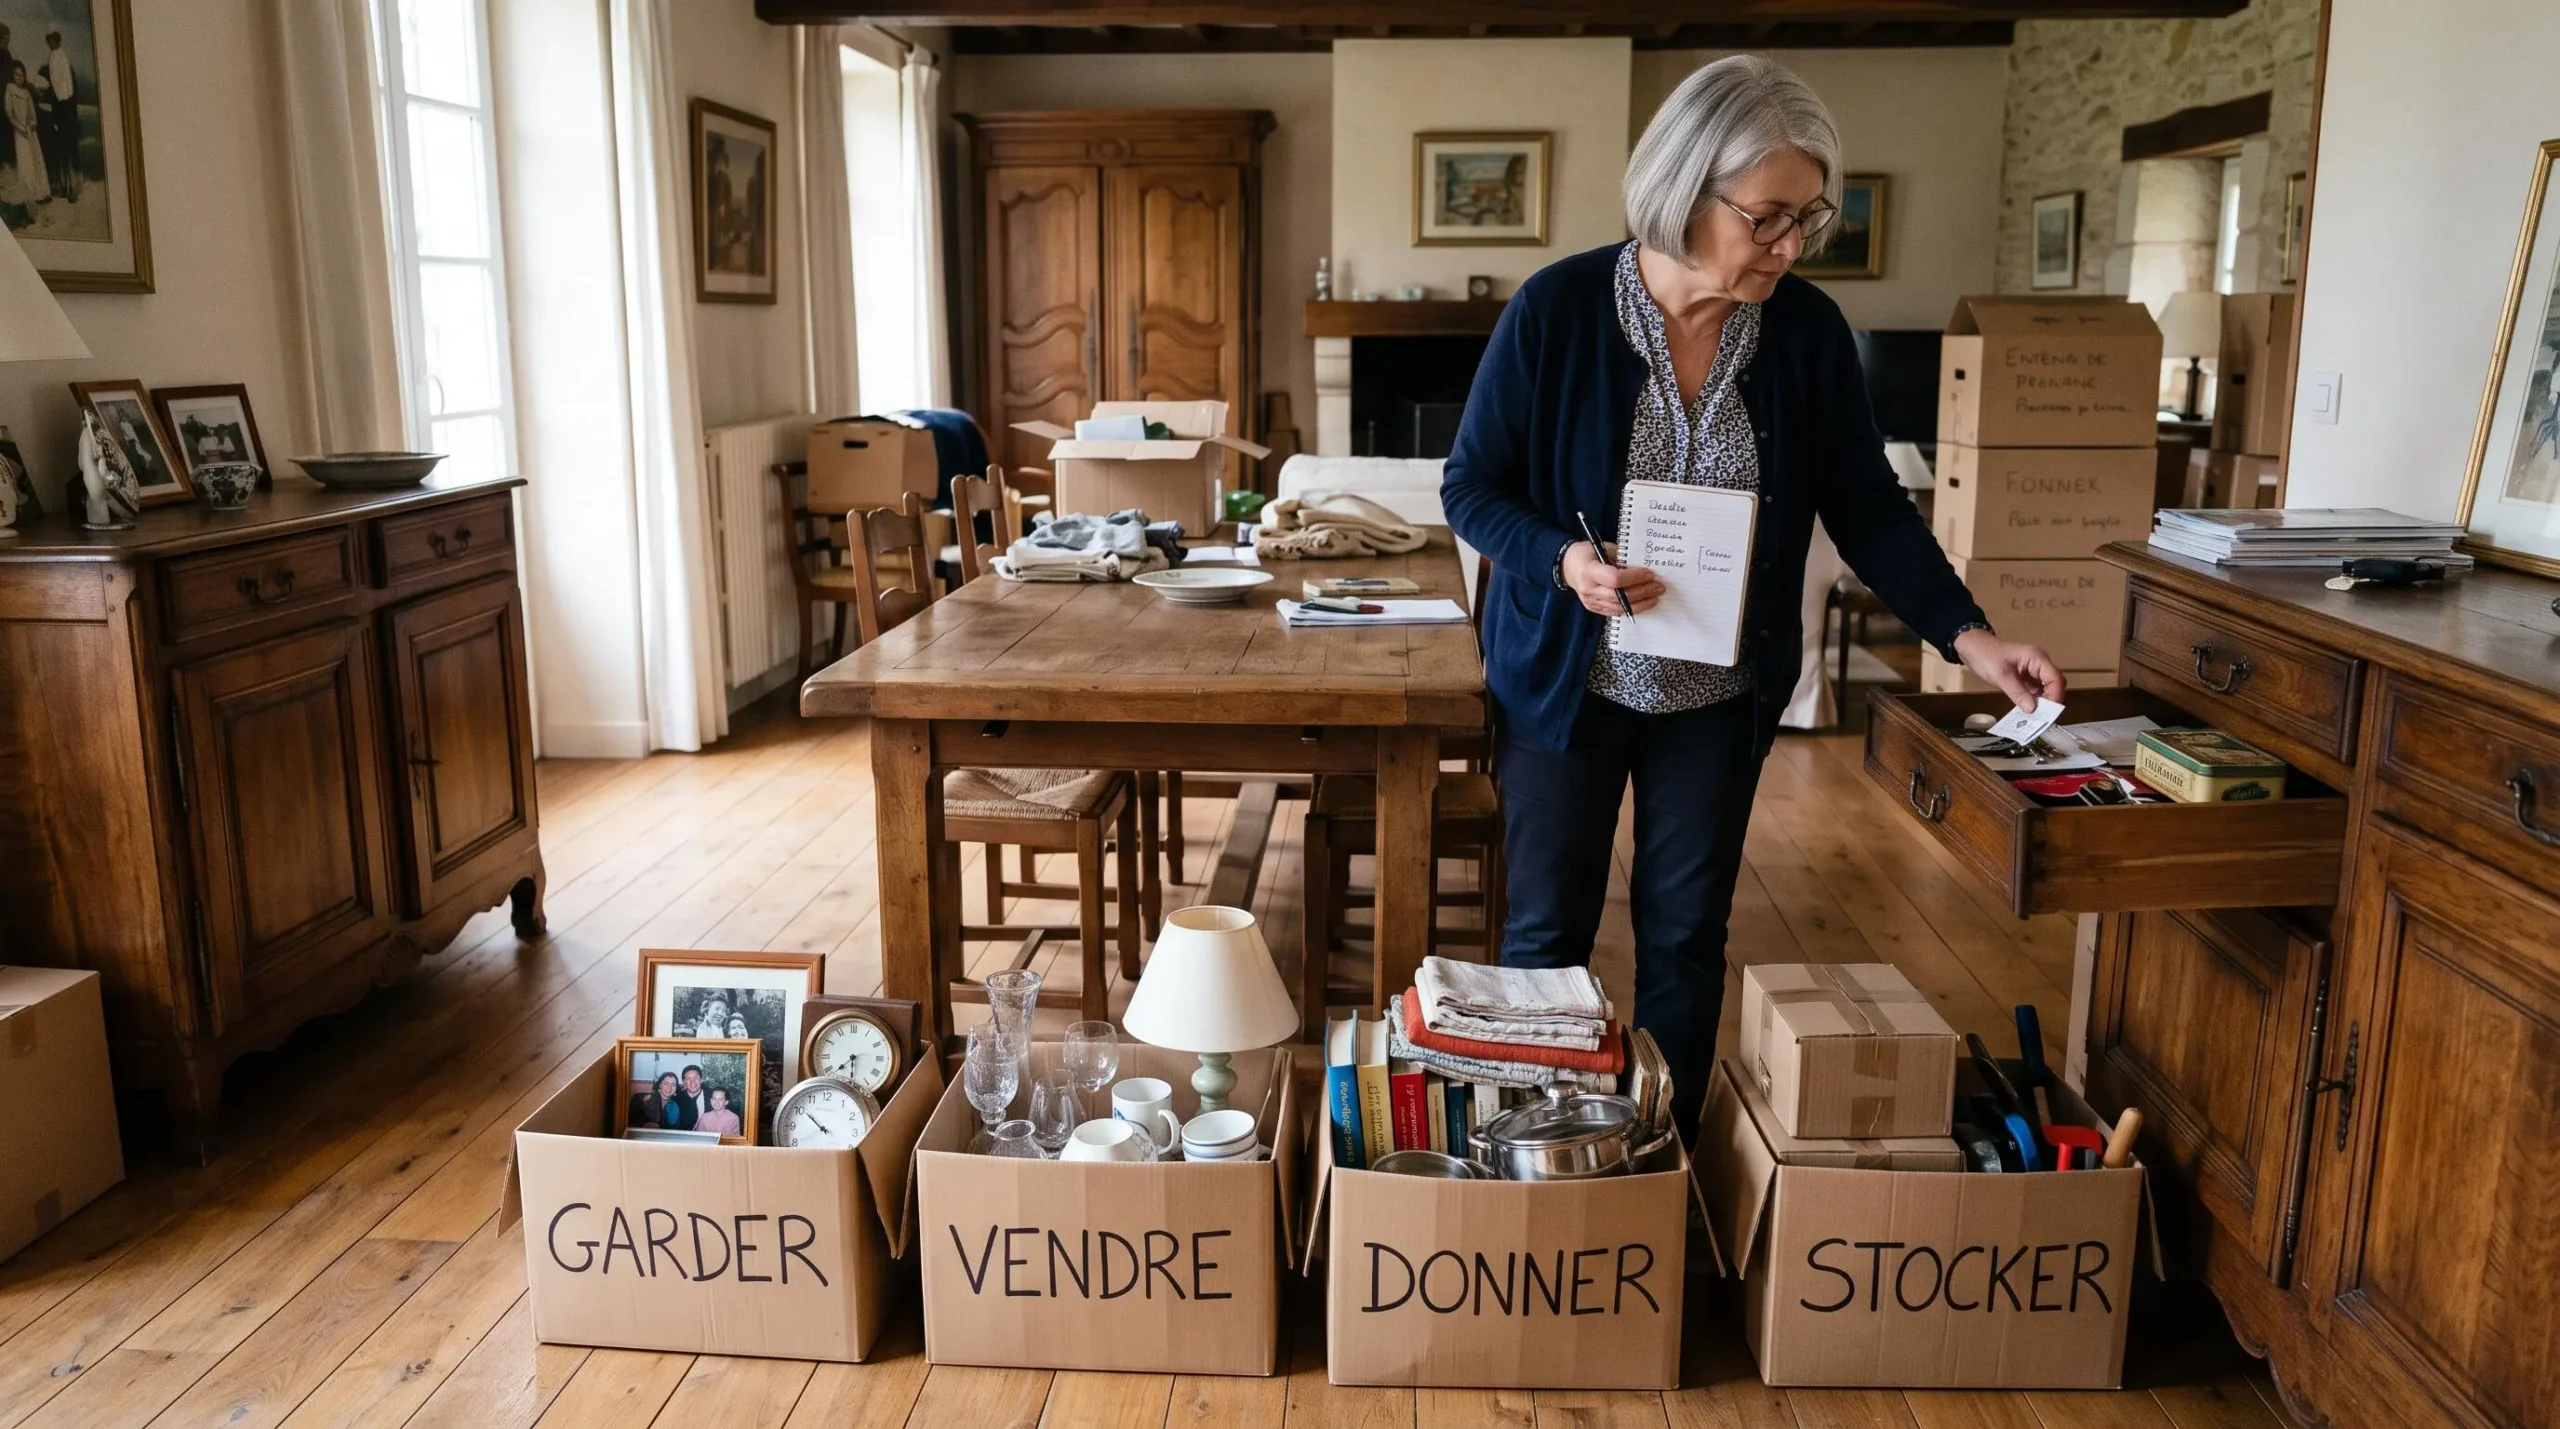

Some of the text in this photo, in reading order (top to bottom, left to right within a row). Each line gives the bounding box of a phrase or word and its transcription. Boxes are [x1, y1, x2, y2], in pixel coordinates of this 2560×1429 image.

[807, 1095, 816, 1105] 11
[822, 1091, 832, 1101] 12
[848, 1112, 856, 1121] 2
[789, 1121, 796, 1131] 9
[851, 1128, 859, 1137] 3
[791, 1138, 798, 1147] 8
[547, 1202, 829, 1288] GARDER
[948, 1223, 1233, 1301] VENDRE
[1361, 1241, 1661, 1316] DONNER
[1799, 1238, 2113, 1315] STOCKER
